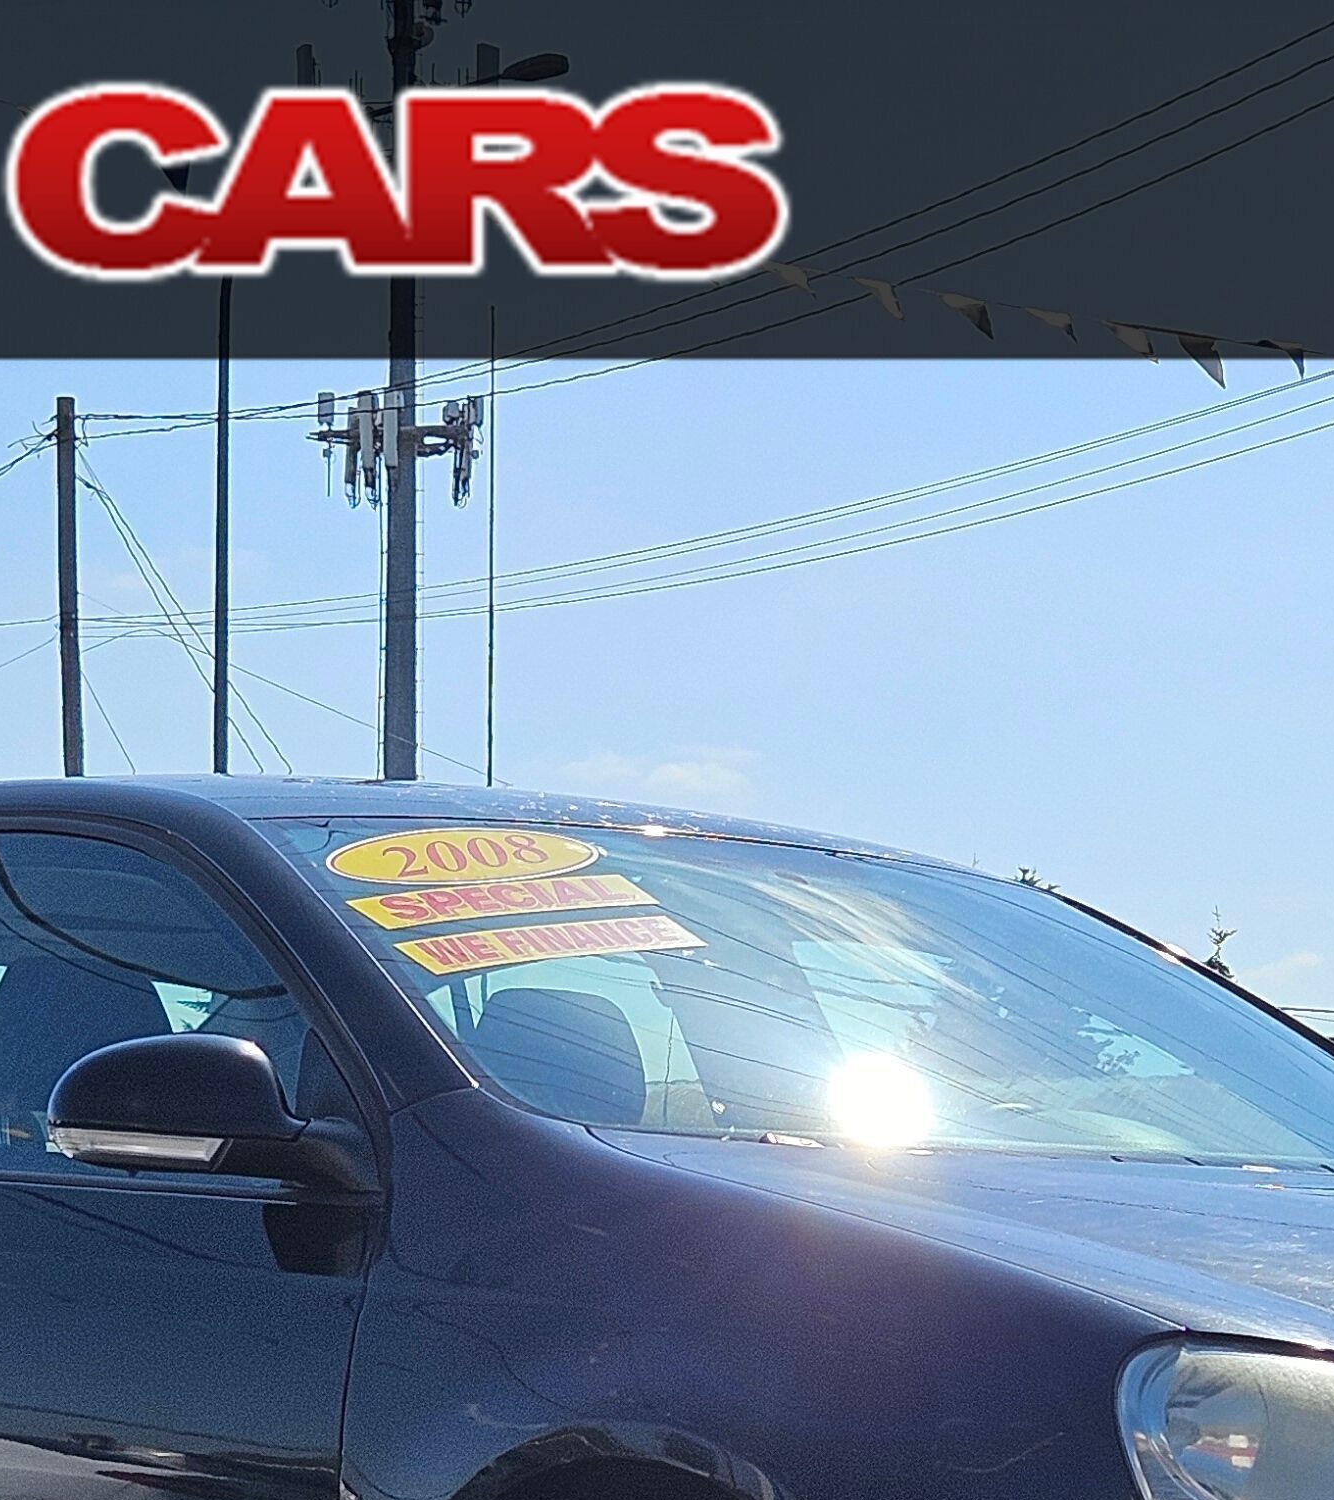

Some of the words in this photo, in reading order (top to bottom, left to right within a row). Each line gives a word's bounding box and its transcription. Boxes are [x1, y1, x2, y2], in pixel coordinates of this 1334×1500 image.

[382, 834, 548, 878] 2008
[378, 876, 637, 920] SPECIAL
[414, 937, 497, 967] WE
[498, 917, 680, 958] FINANCE
